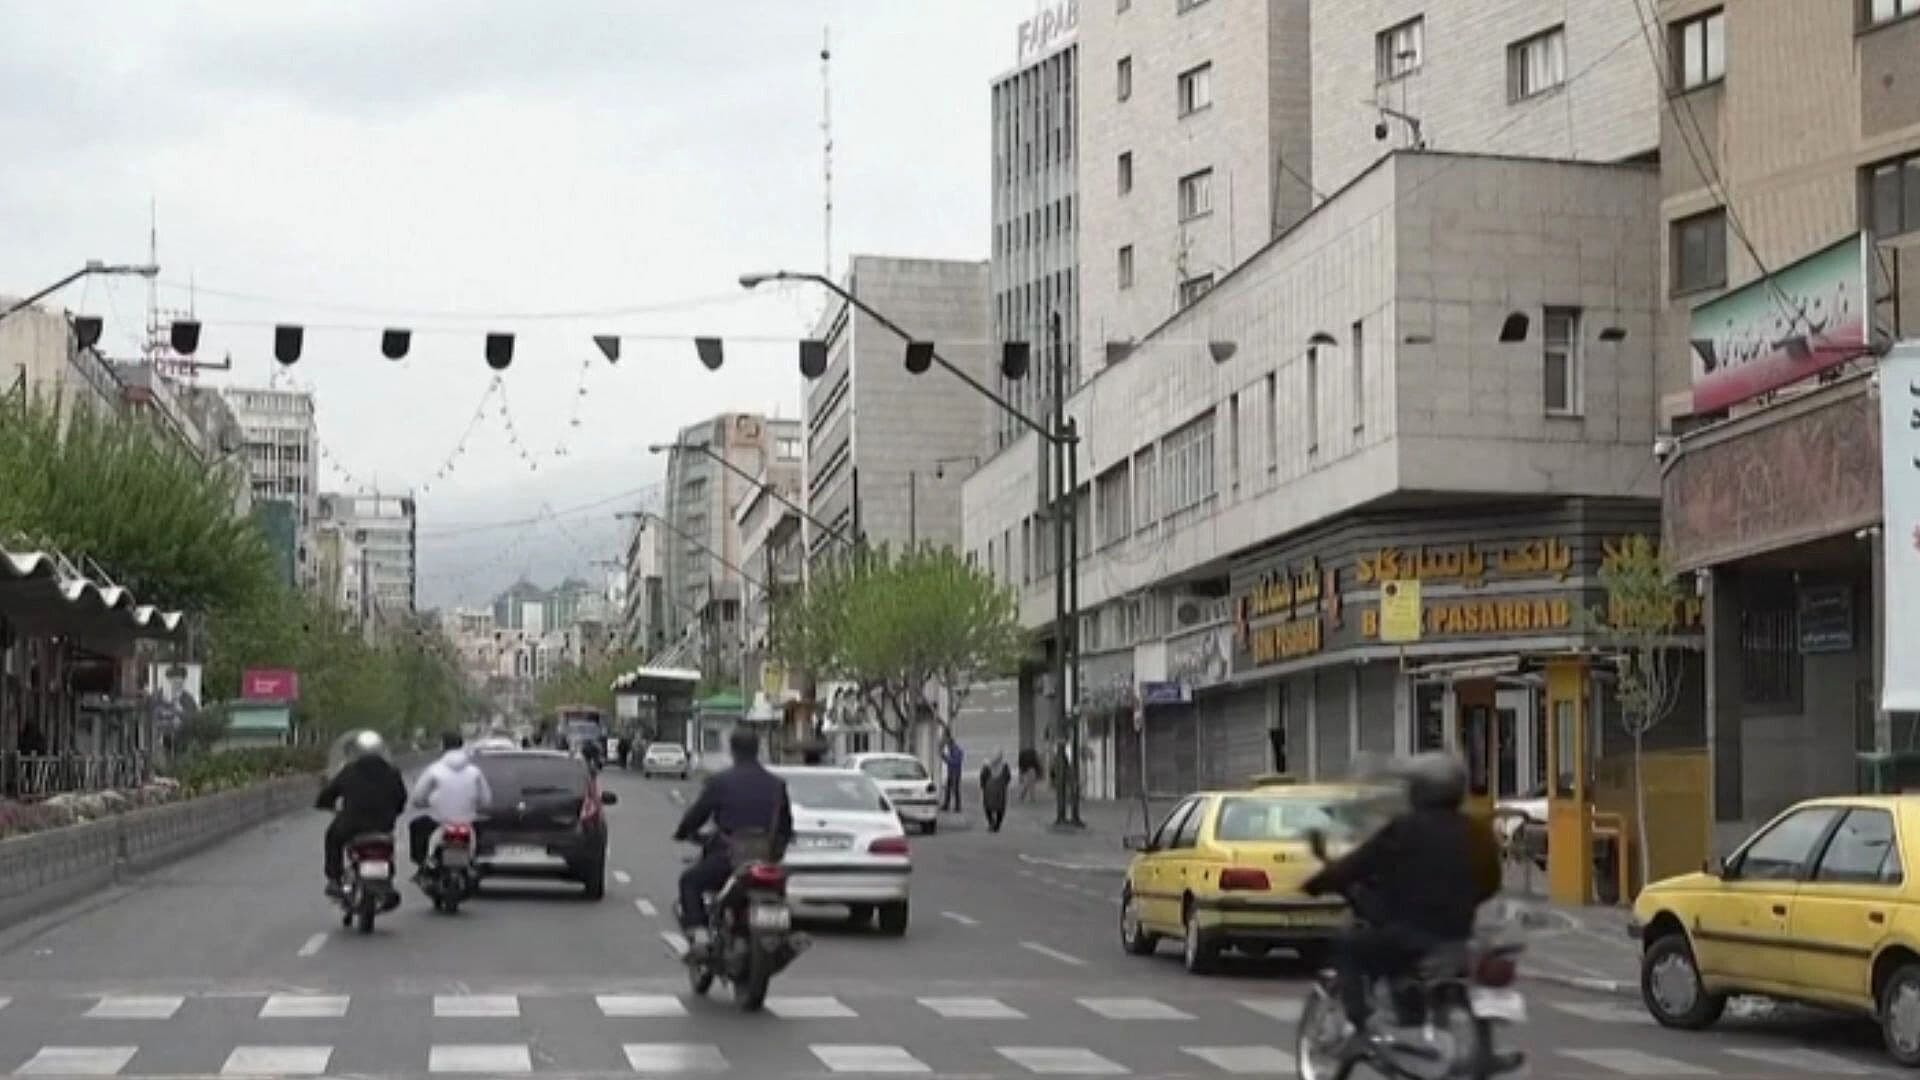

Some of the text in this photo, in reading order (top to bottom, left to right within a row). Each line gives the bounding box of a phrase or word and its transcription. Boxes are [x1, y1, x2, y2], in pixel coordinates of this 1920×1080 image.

[1356, 543, 1487, 589] پاسارگاد
[1502, 537, 1571, 582] بانک
[1434, 600, 1571, 632] PASARGAD
